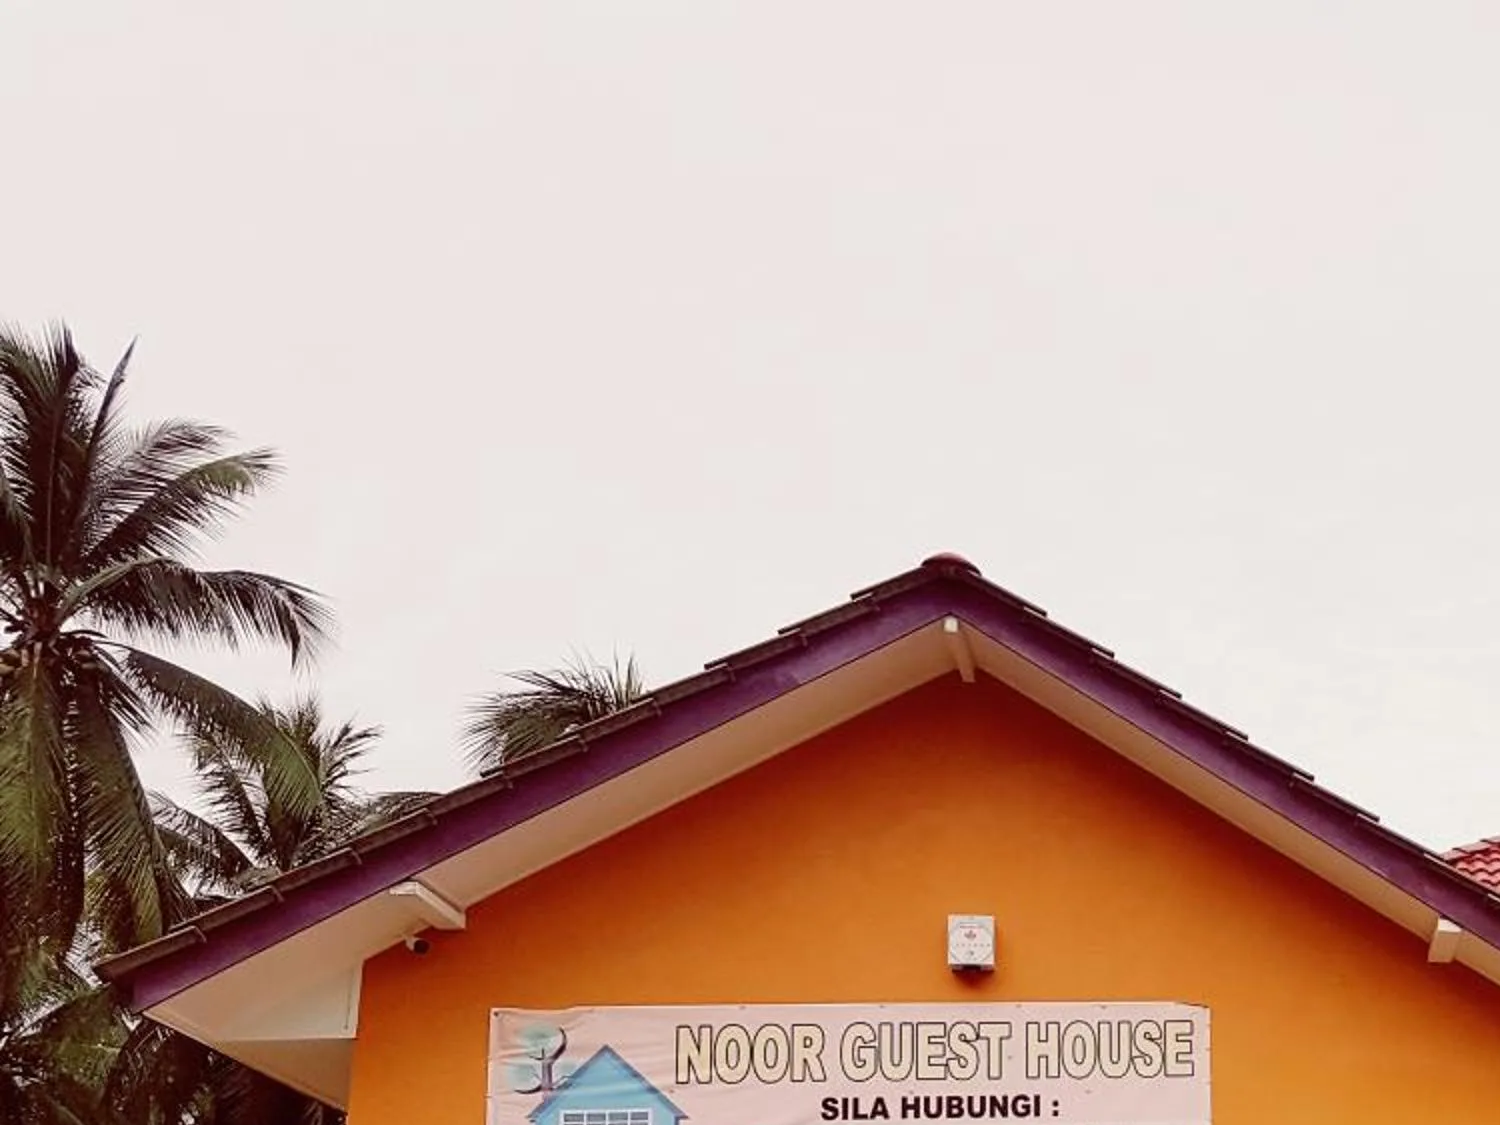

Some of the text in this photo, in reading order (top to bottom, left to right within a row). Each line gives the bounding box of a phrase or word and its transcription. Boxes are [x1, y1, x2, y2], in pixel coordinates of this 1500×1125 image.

[675, 1020, 1195, 1084] NOOR GUEST HOUSE
[820, 1096, 890, 1121] SILA
[900, 1094, 1041, 1119] HUBUNGI
